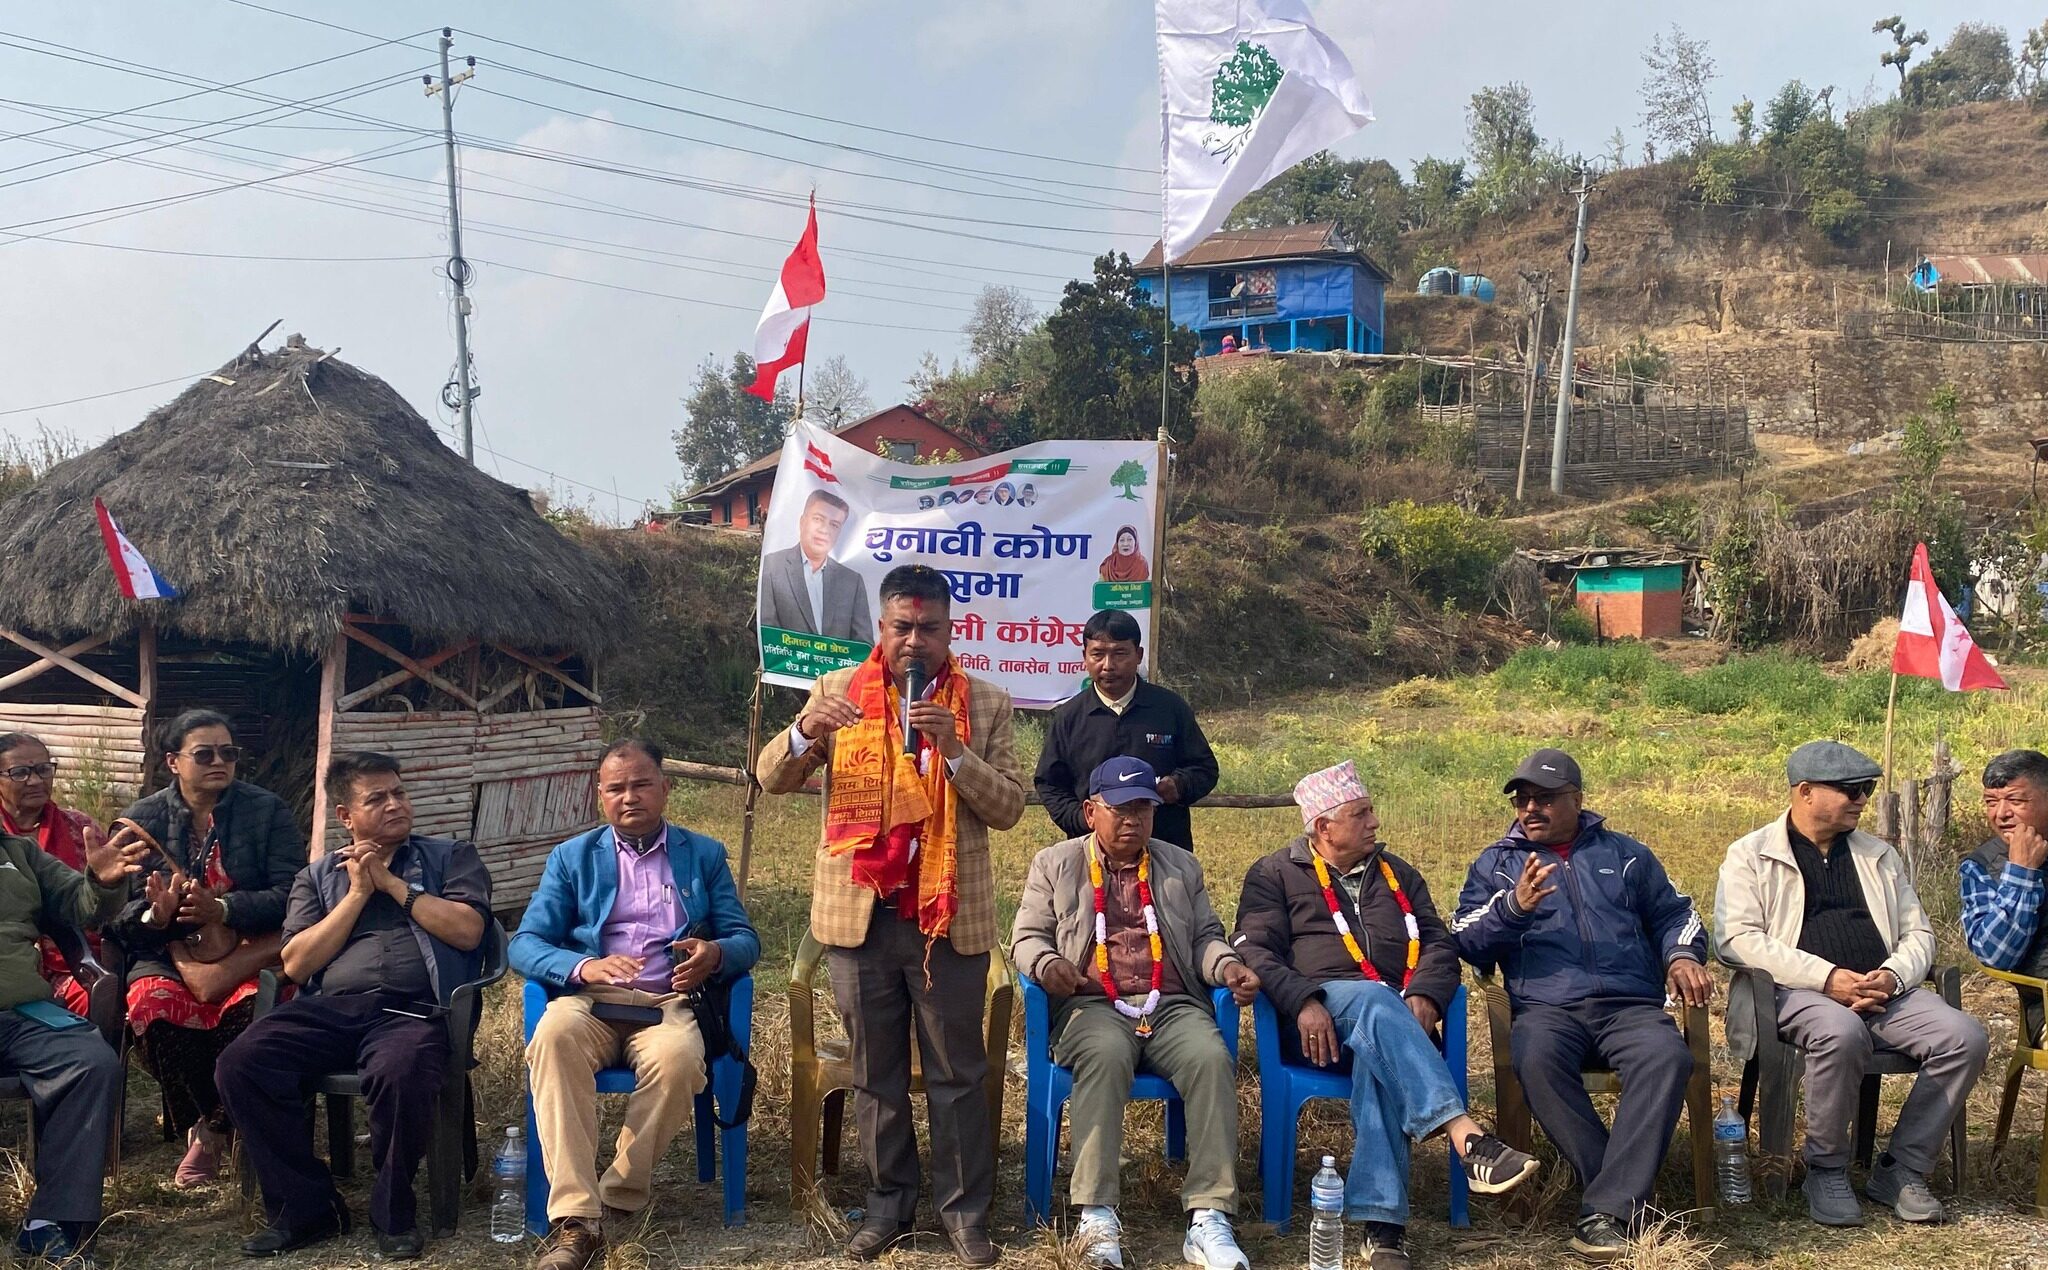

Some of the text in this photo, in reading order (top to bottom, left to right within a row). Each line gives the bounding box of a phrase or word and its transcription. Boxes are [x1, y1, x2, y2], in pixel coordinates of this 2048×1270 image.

[865, 521, 1092, 562] चुनावी कोण
[940, 569, 1023, 603] सभा
[763, 643, 793, 657] प्रतिनिधि
[796, 650, 809, 661] सभा
[781, 633, 811, 647] हिमाल
